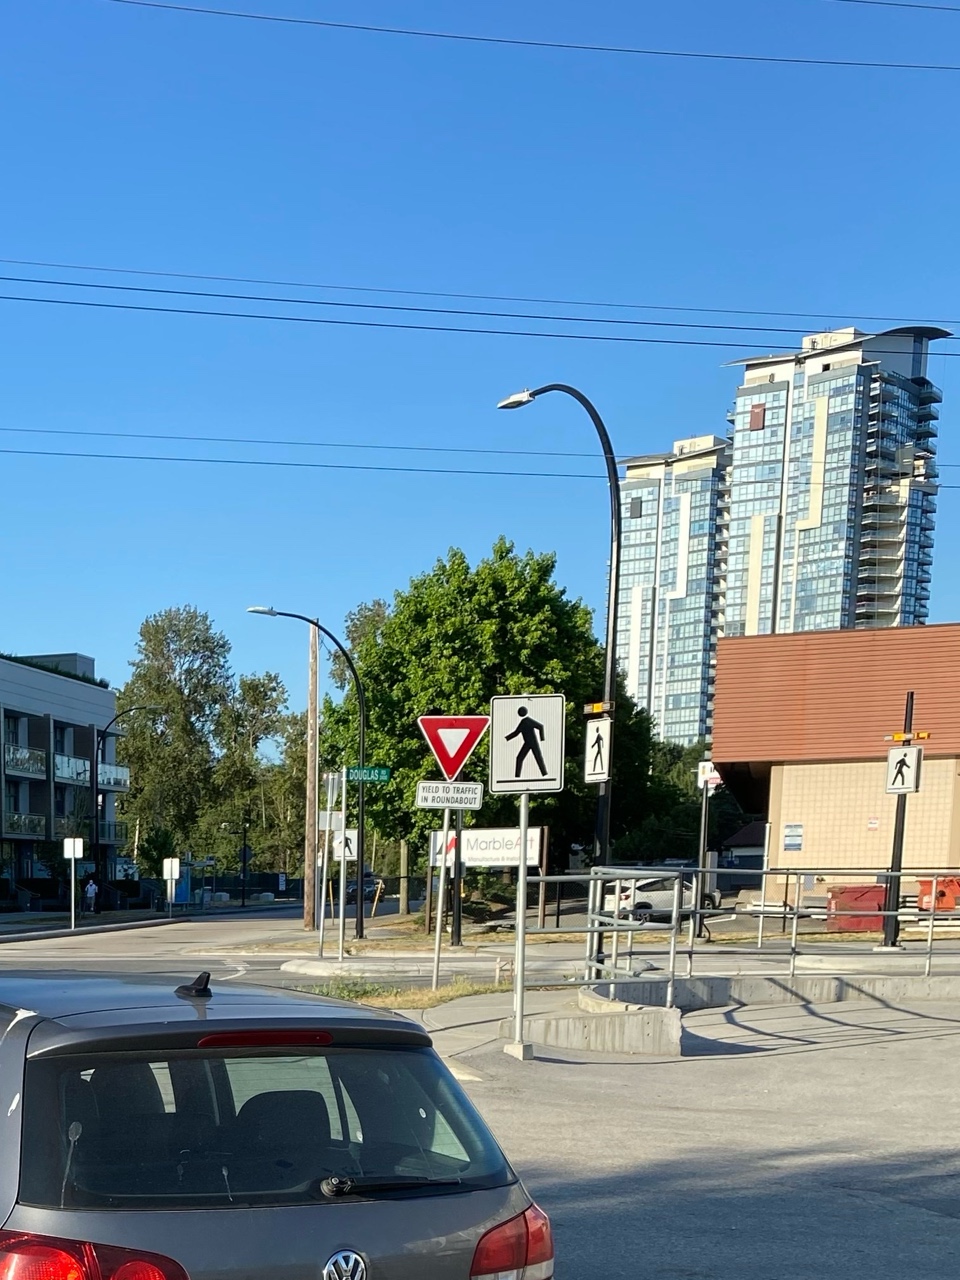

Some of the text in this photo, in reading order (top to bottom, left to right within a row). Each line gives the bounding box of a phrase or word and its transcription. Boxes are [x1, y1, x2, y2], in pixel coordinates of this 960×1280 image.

[349, 769, 379, 780] DOUGLAS
[422, 785, 478, 795] YIELD TO TRAFFIC
[421, 795, 477, 805] IN ROUNDABOUT
[466, 836, 534, 850] MarbleAt
